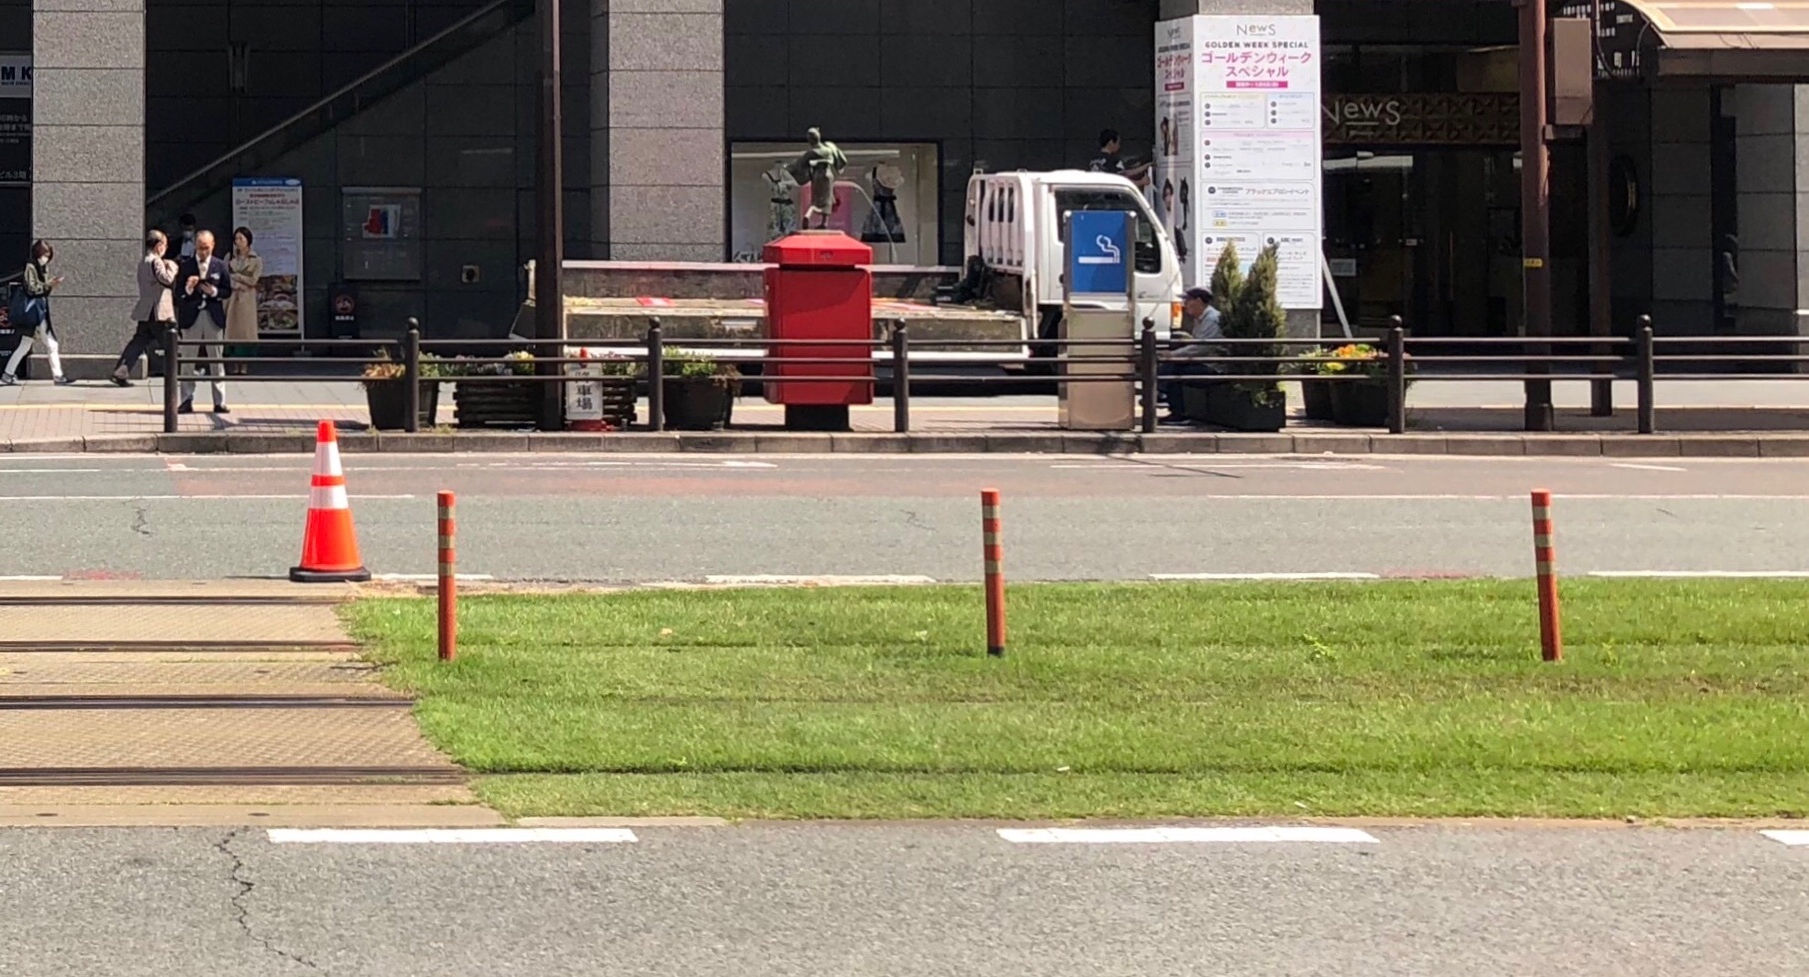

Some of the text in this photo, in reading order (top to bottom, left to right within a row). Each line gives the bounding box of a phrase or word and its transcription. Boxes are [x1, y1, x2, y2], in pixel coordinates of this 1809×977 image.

[1205, 41, 1308, 49] GOLDEN WEEK SPECIAL
[1201, 51, 1312, 64] ゴールデンウィーク
[1225, 66, 1289, 77] スペシャル
